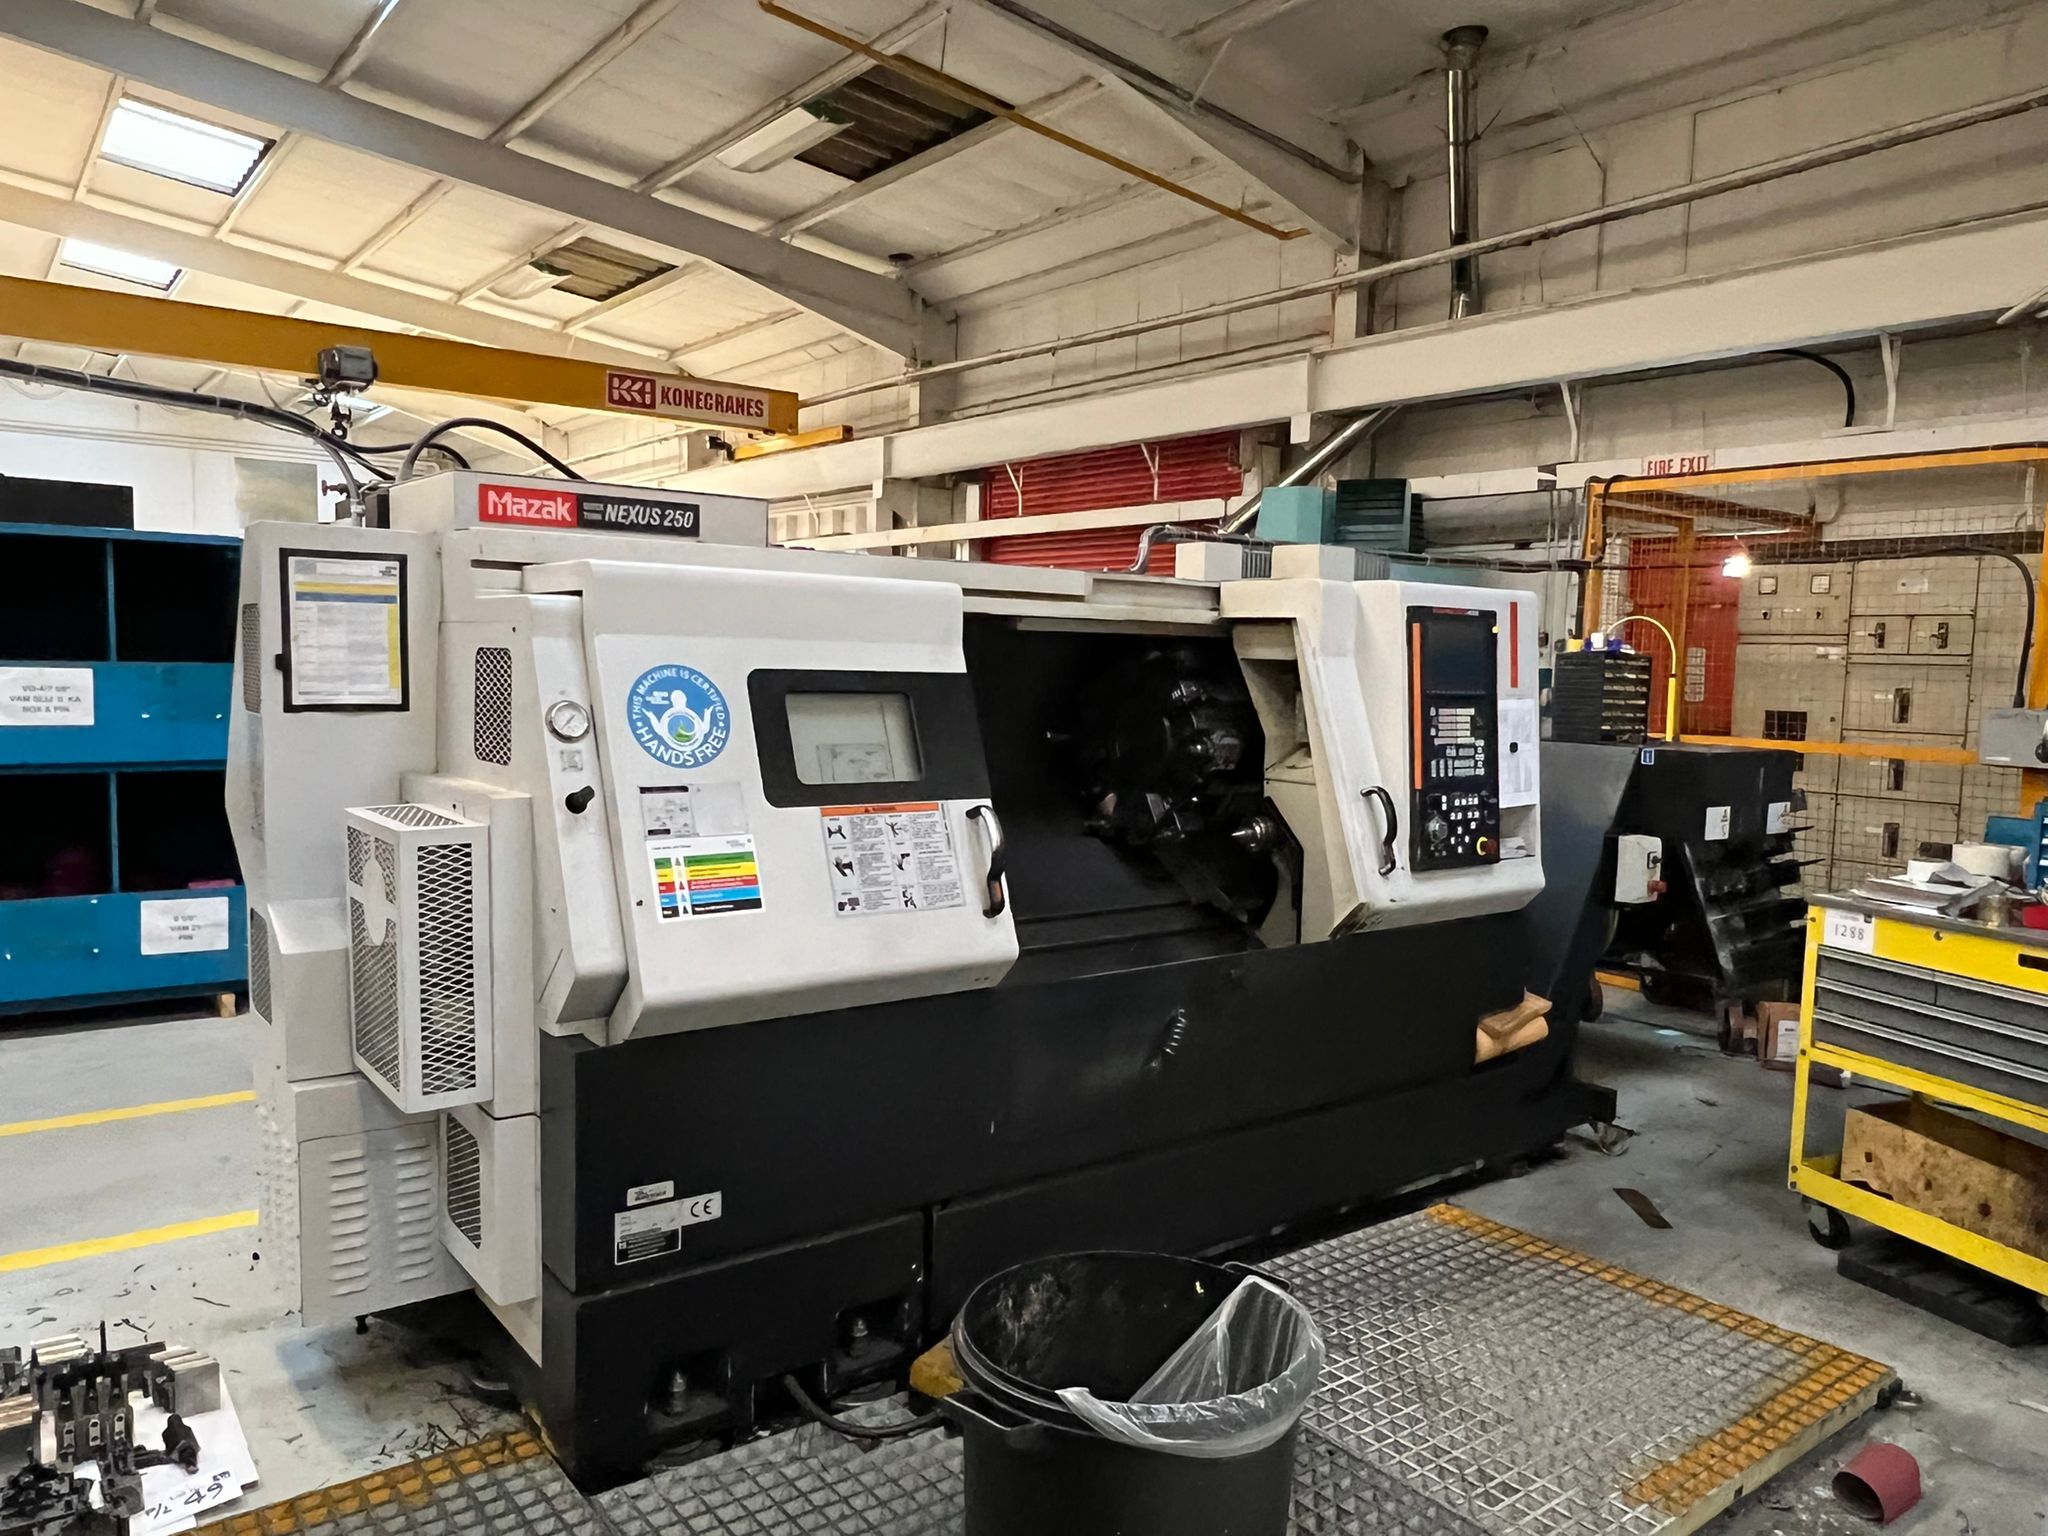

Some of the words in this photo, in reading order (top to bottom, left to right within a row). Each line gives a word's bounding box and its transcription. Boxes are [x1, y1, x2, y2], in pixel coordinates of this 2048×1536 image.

[661, 386, 764, 418] KONECRANES
[1647, 458, 1674, 476] FIRE
[1680, 455, 1709, 473] EXIT
[487, 490, 572, 521] Mazak
[605, 503, 661, 525] NEXUS
[663, 509, 694, 529] 250
[636, 668, 678, 695] MACHINE
[679, 668, 690, 680] IS
[632, 696, 643, 720] THIS
[690, 674, 726, 721] CERTIFIED
[1834, 923, 1865, 941] 1288
